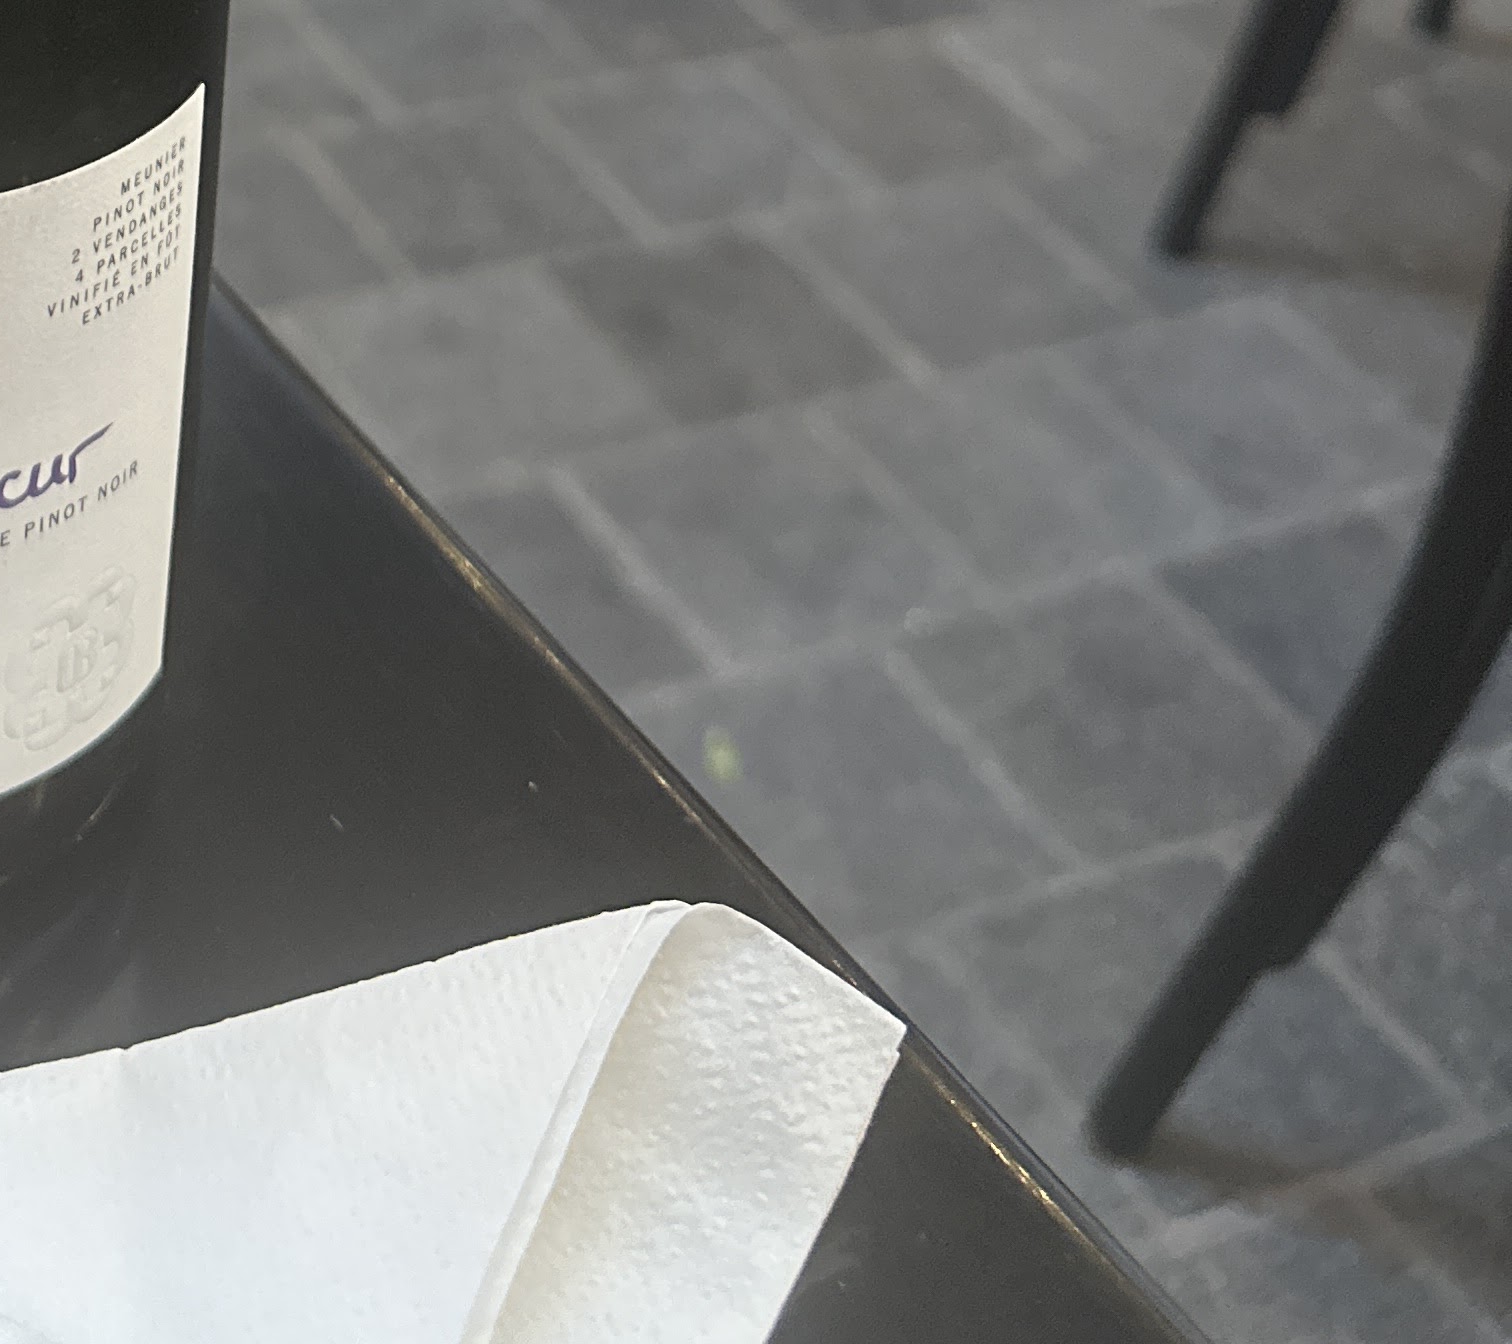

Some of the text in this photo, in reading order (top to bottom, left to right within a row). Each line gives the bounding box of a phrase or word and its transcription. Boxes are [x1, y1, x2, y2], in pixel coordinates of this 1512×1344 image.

[92, 159, 185, 232] PINOT NOIR
[120, 136, 187, 196] MEUNIER
[71, 181, 184, 264] 2 VENDANGES
[75, 202, 182, 283] 4 PARCELLES
[47, 268, 120, 318] VINIFIÉ
[131, 256, 149, 277] EN
[82, 248, 179, 325] EXTRA-BRUT
[23, 498, 89, 542] PINOT
[96, 459, 140, 501] NOIR
